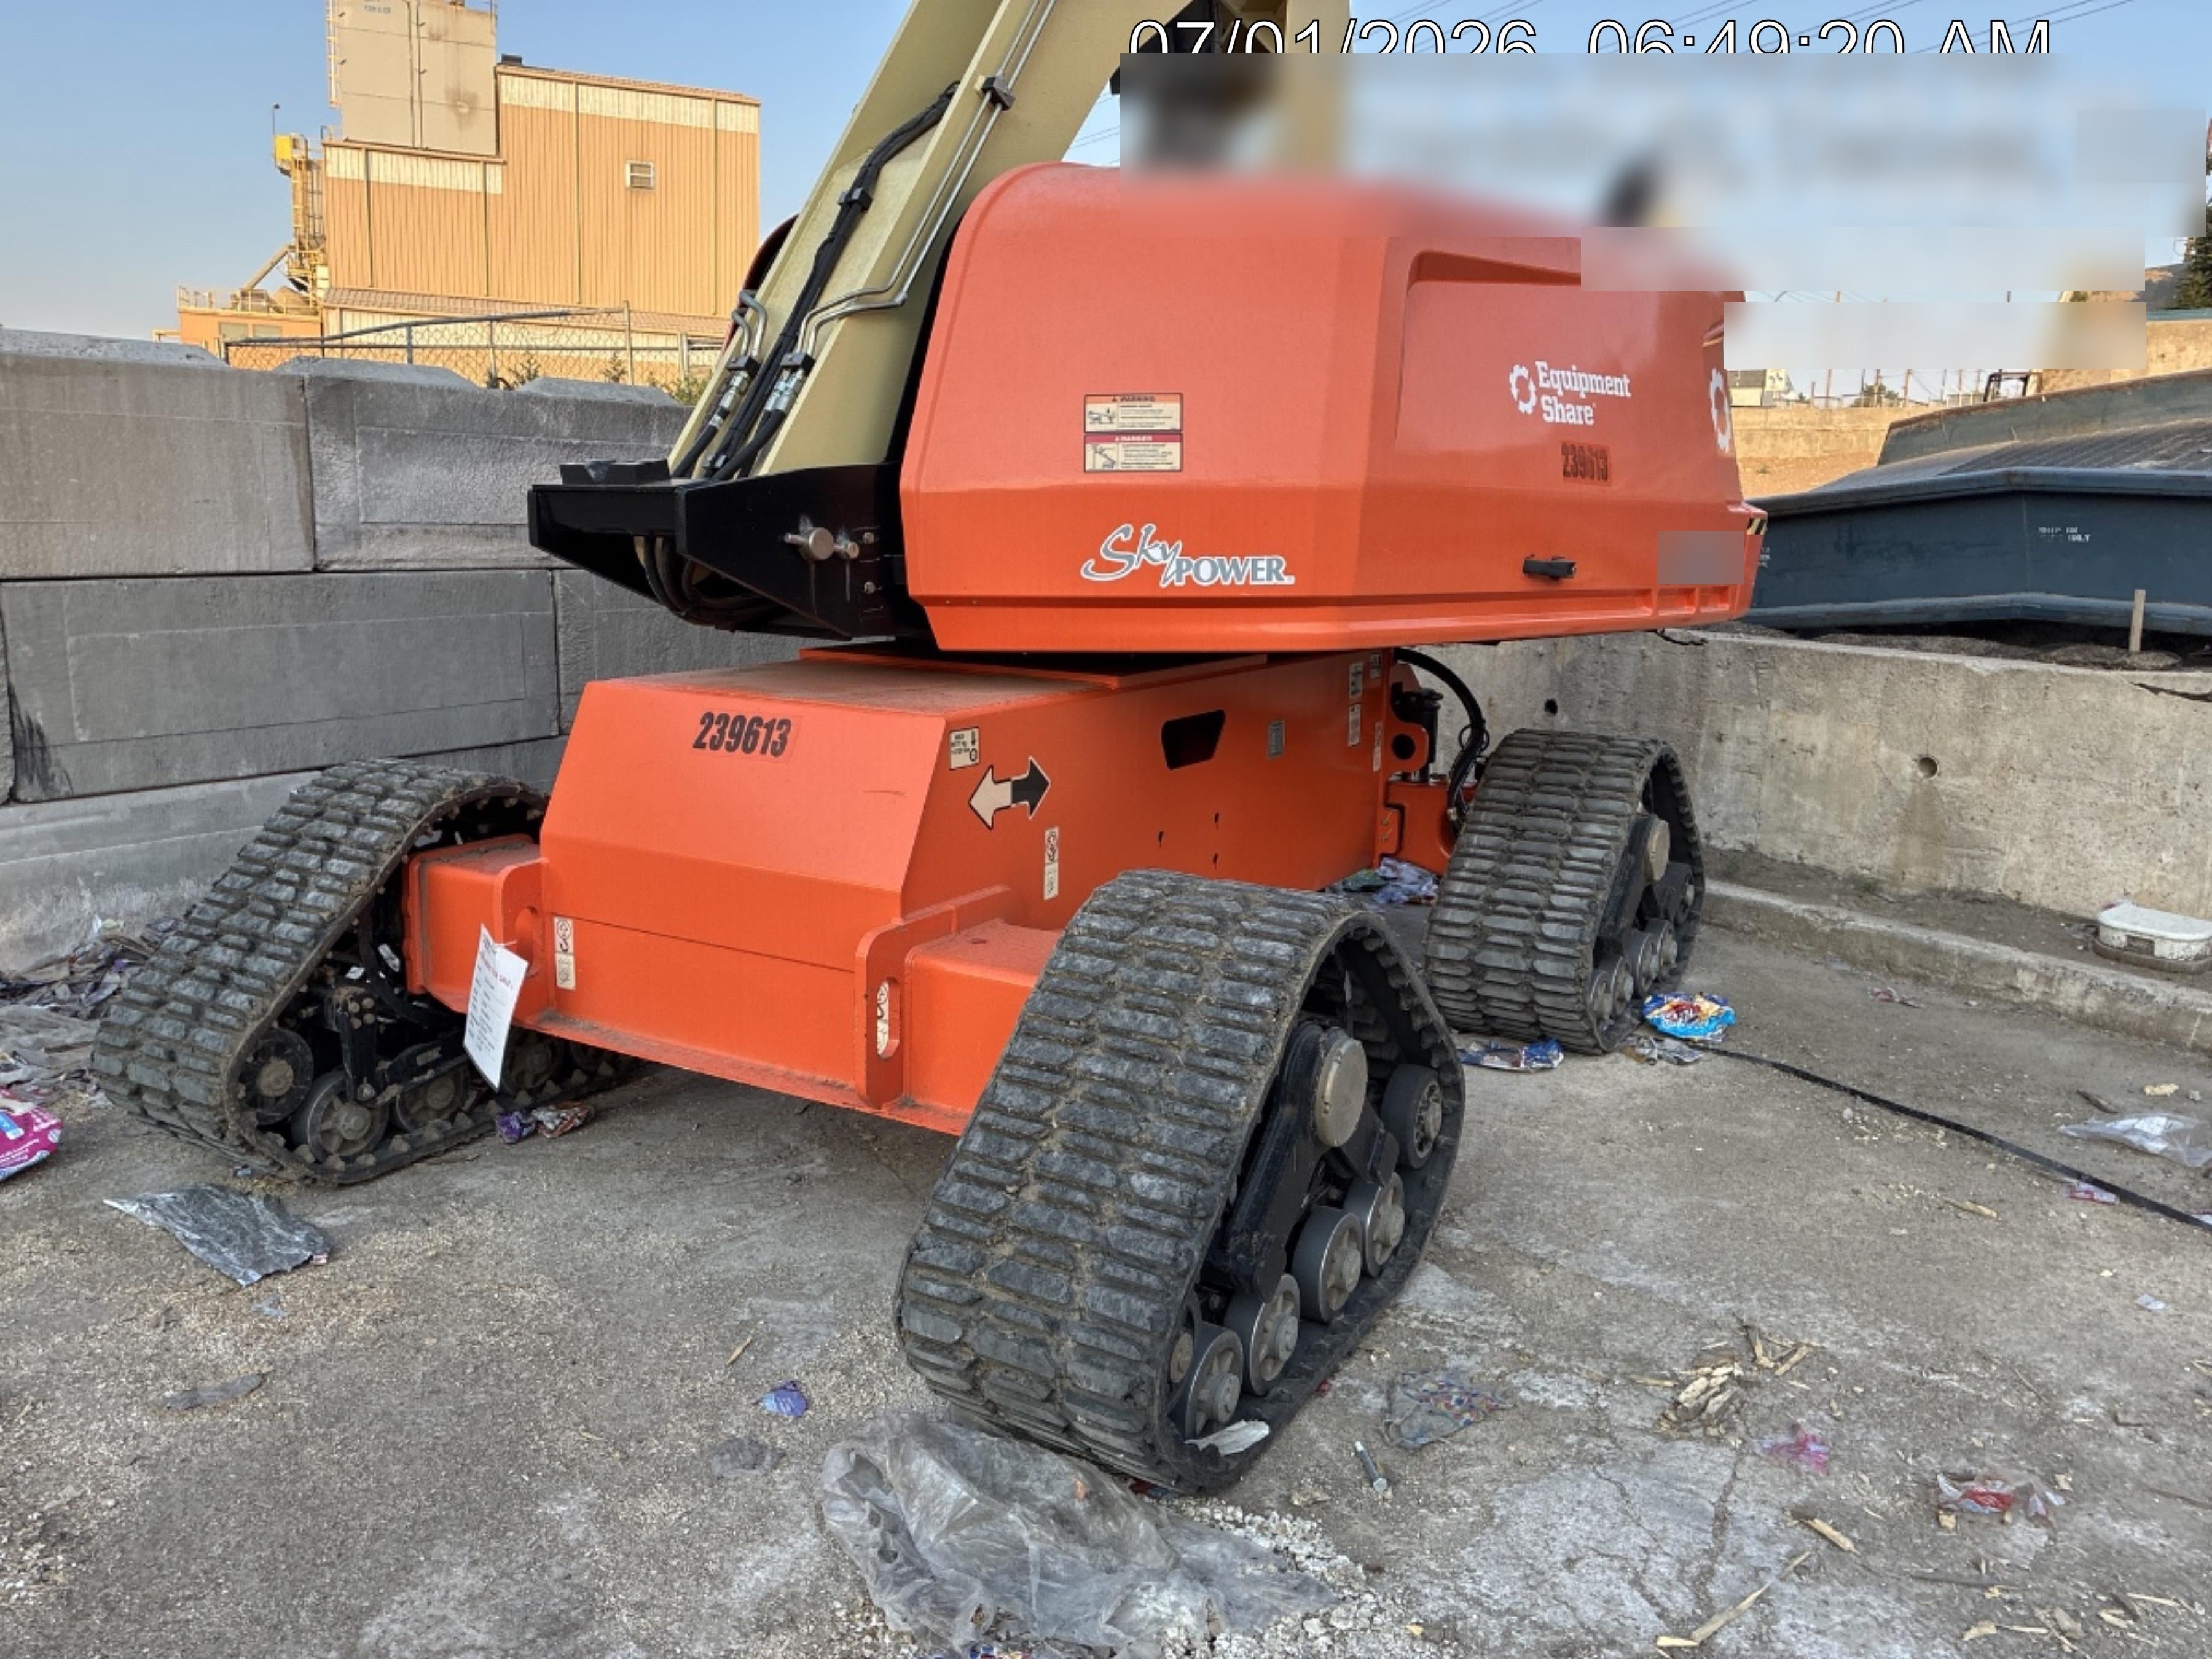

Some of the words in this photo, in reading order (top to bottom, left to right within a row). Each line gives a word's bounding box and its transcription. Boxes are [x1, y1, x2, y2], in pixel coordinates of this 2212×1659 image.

[1535, 360, 1632, 399] Equipment
[1540, 394, 1595, 425] Share
[692, 711, 792, 758] 239613
